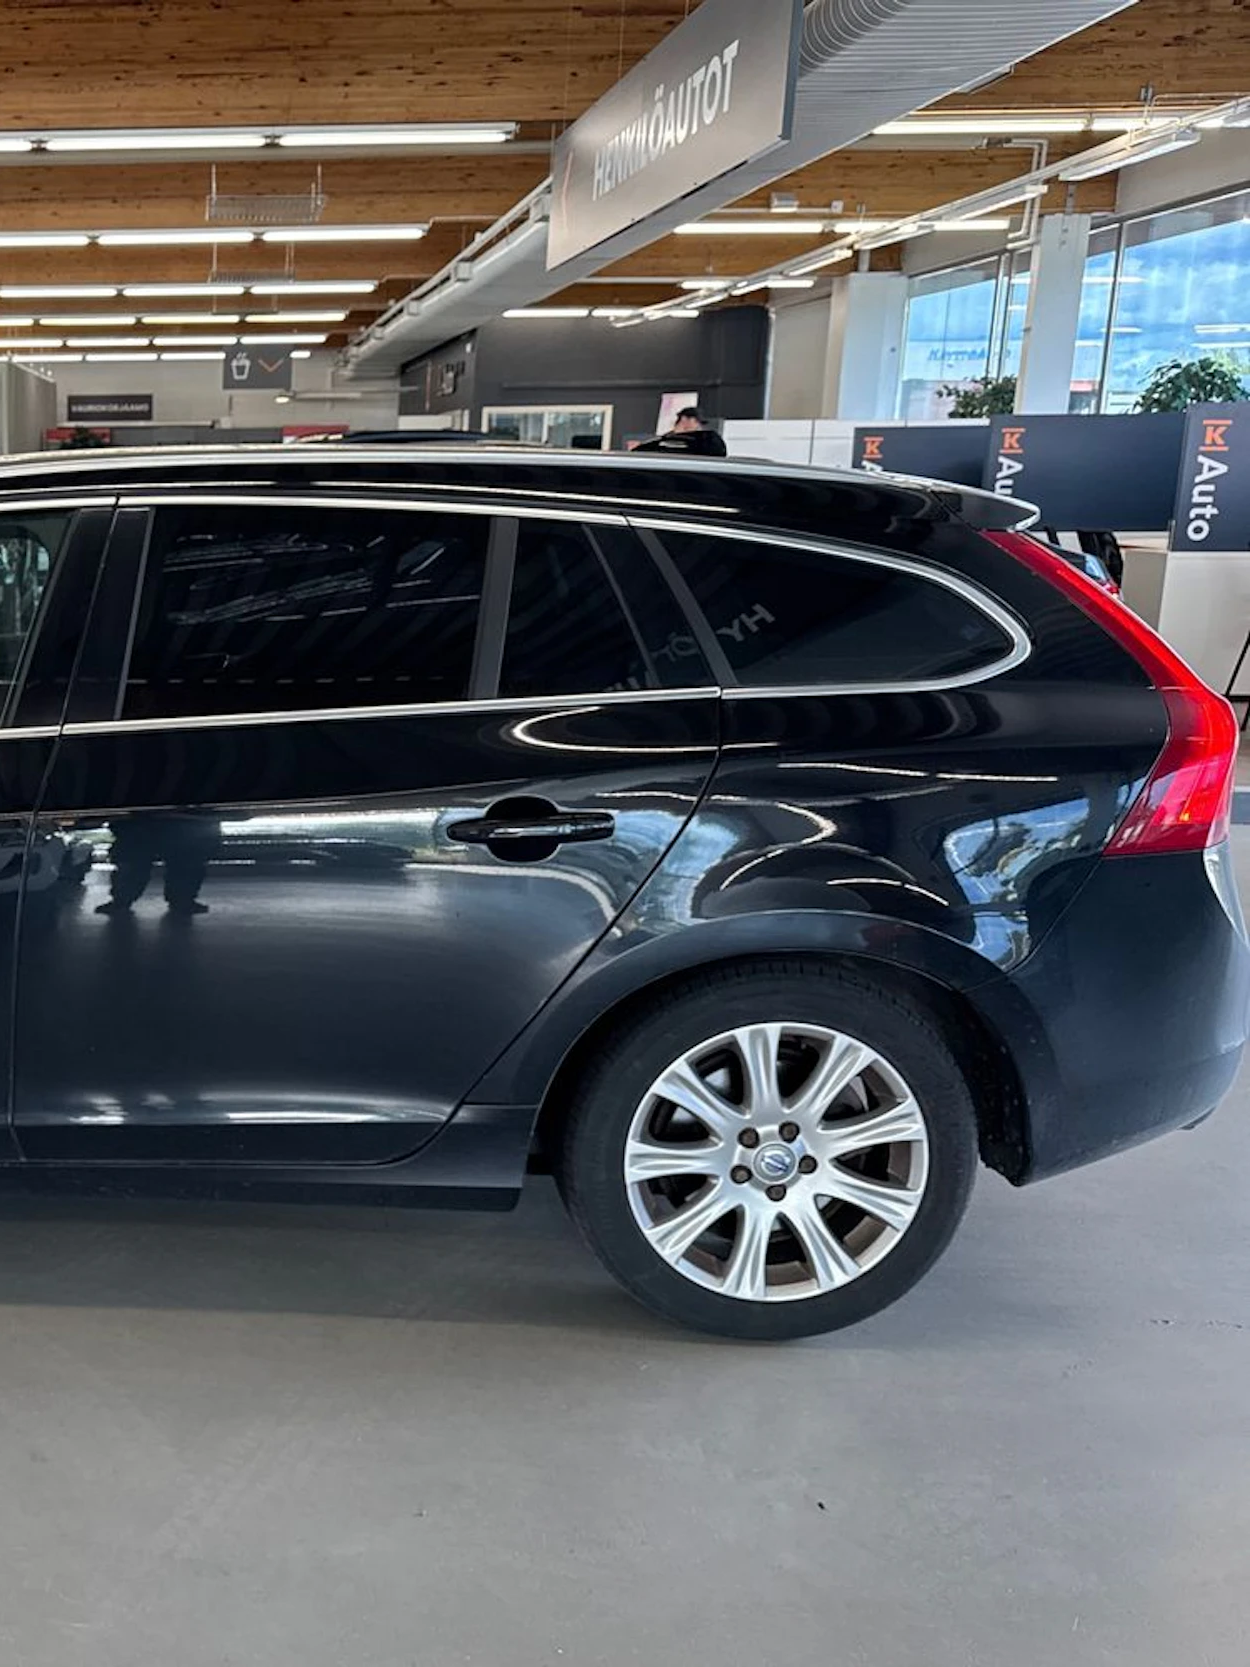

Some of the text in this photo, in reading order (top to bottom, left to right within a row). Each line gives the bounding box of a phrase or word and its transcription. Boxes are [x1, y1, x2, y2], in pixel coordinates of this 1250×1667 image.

[592, 38, 740, 202] HENKILÖAUTOT
[994, 430, 1025, 496] K Au
[1186, 422, 1231, 542] K Auto
